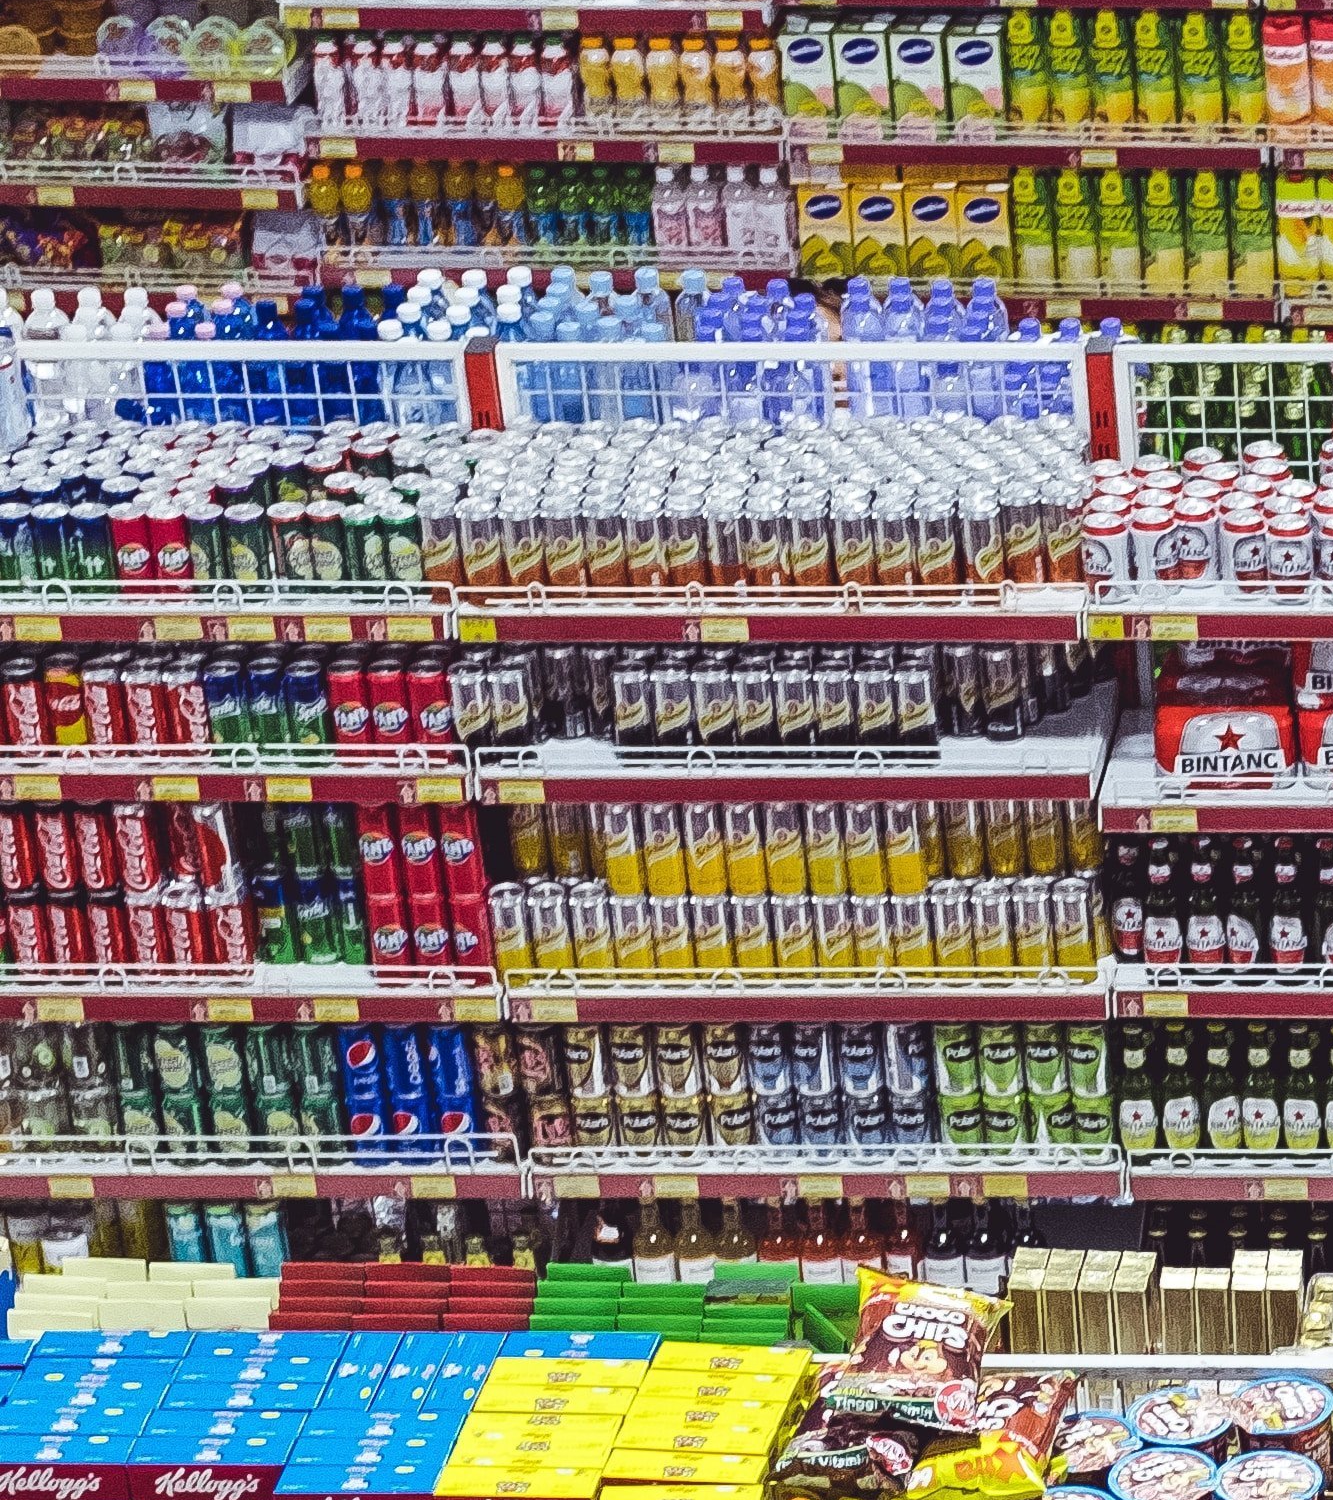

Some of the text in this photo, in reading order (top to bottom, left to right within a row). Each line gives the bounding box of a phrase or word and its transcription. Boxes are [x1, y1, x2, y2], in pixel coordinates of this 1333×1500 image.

[1181, 752, 1279, 774] BINTANG
[894, 1303, 966, 1326] CHOCO
[882, 1314, 968, 1349] CHIPS
